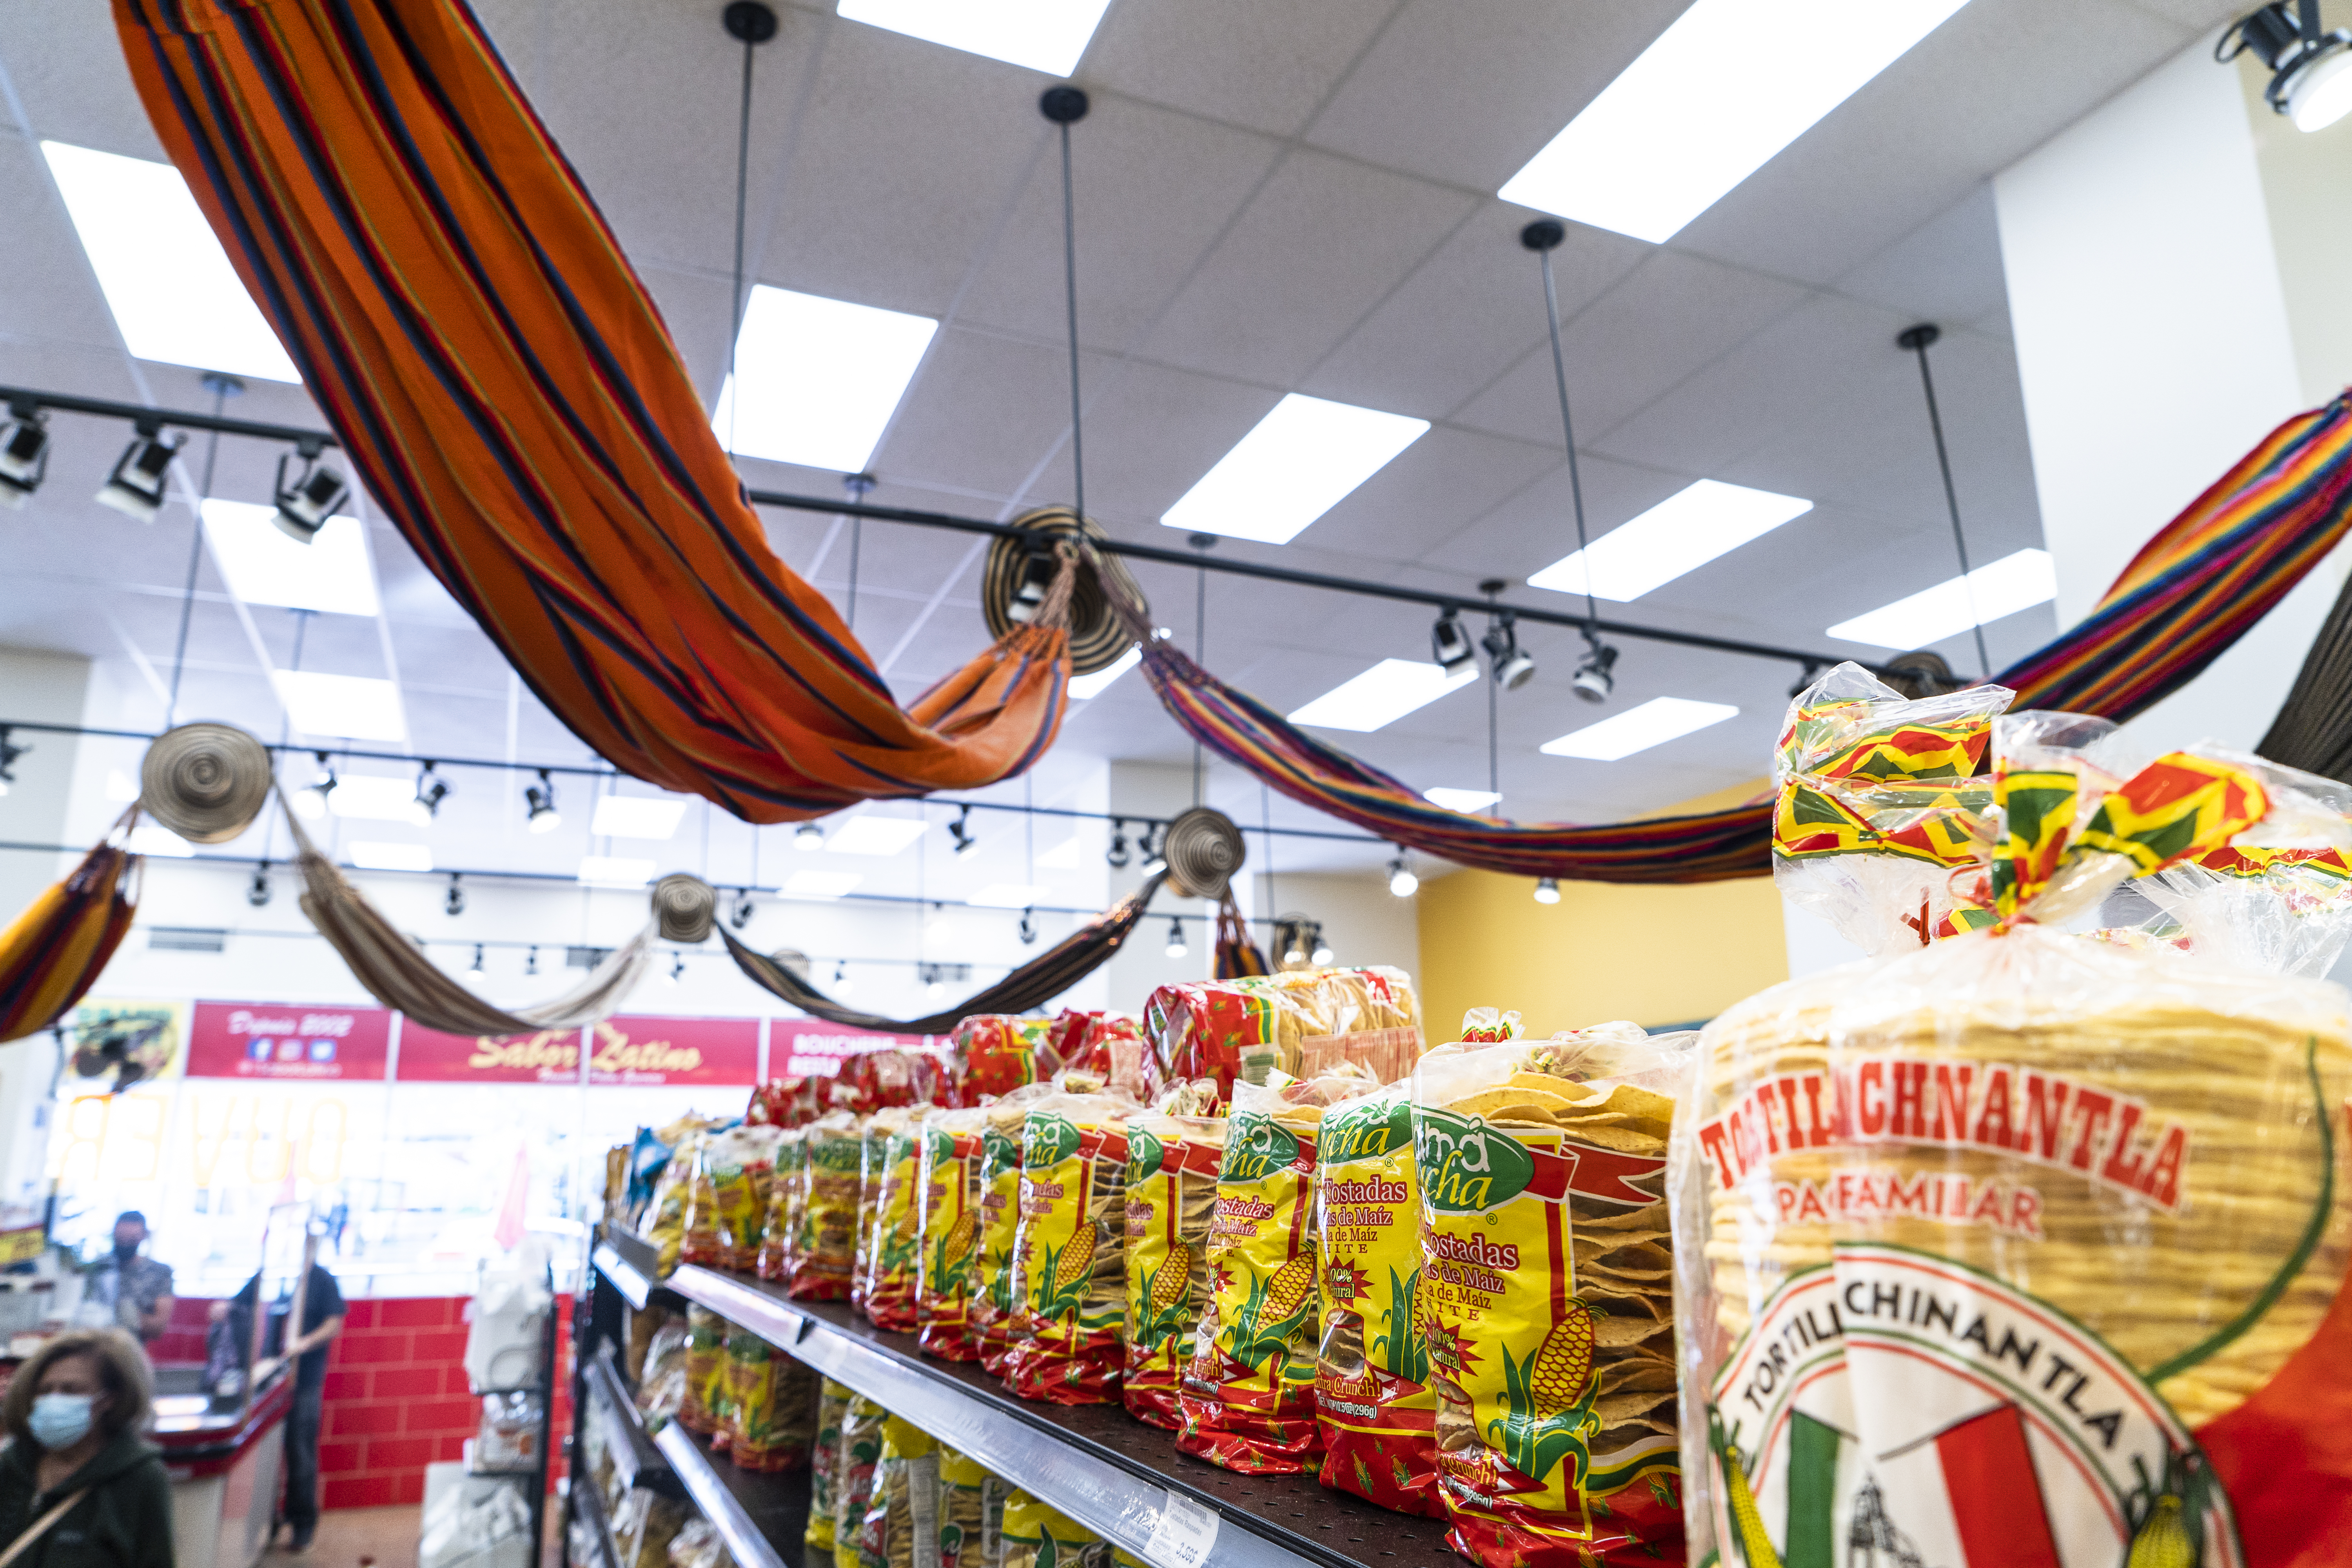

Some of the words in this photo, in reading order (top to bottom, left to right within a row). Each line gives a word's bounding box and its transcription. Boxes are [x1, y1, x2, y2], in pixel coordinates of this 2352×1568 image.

[1323, 1175, 1407, 1204] Tostadas
[1338, 1207, 1354, 1226] de
[1355, 1206, 1393, 1225] Maíz
[1335, 1227, 1347, 1241] de
[1350, 1227, 1377, 1241] Maíz
[1330, 1269, 1352, 1282] 00%
[1441, 1262, 1461, 1284] de
[1461, 1266, 1505, 1294] Maíz
[1426, 1295, 1480, 1321] HITE
[1437, 1283, 1453, 1301] de
[1457, 1287, 1492, 1310] Maíz
[1432, 1326, 1456, 1351] 100%
[1844, 1280, 2125, 1450] CHINANTLA
[1332, 1377, 1381, 1397] Crunch!
[1353, 1403, 1377, 1419] (296g)
[1448, 1453, 1497, 1487] Crunch!
[1176, 1542, 1198, 1565] 3,59$
